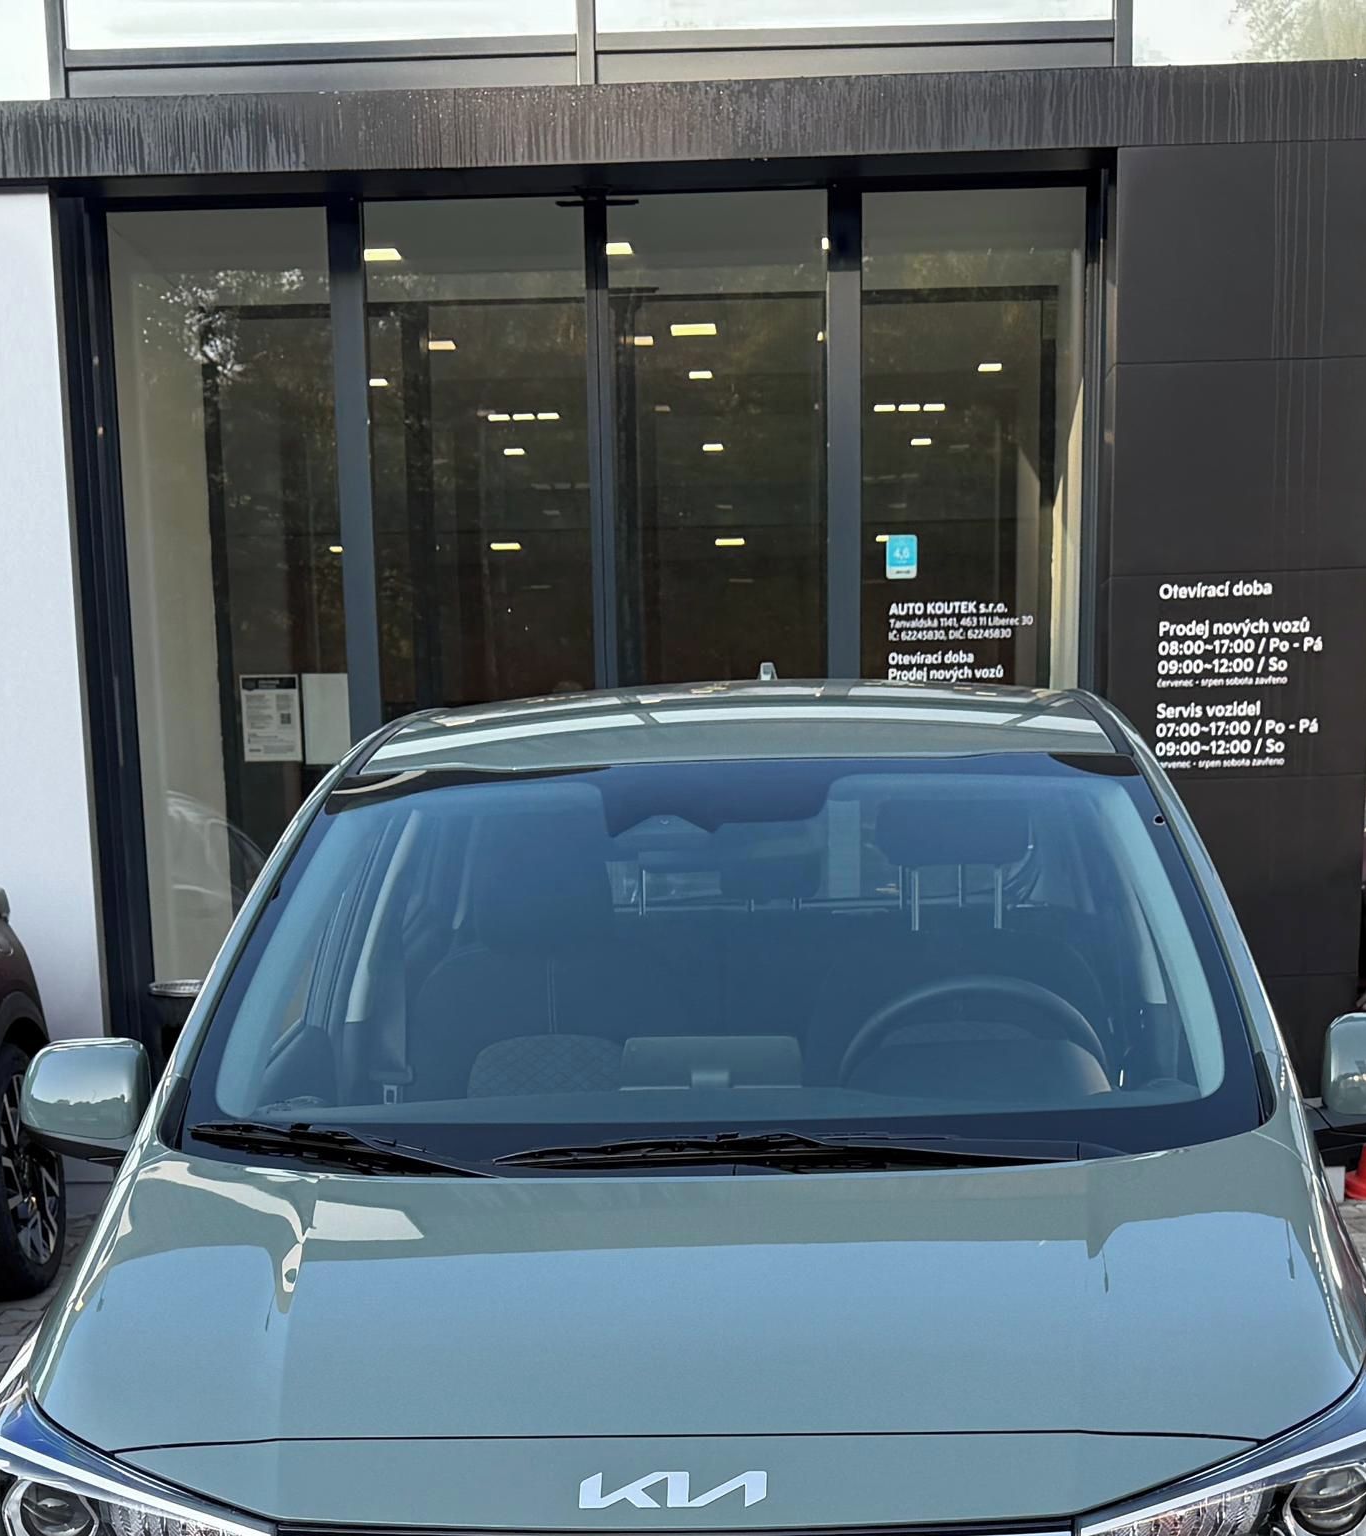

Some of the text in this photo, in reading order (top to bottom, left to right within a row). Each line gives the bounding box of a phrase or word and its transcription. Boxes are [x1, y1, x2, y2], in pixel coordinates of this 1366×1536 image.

[1158, 579, 1273, 600] Otevírací doba
[888, 600, 1008, 616] AUTO KOUTEK s.r.o.
[960, 615, 978, 627] 463
[978, 615, 987, 627] 11
[987, 615, 1020, 627] Liberec
[1021, 615, 1034, 626] 30
[1158, 616, 1311, 640] Prodej nových vozů
[888, 629, 900, 641] IČ:
[948, 628, 966, 640] DIČ:
[1157, 638, 1255, 656] 08:00~17:00
[1257, 637, 1267, 655] /
[1269, 637, 1290, 653] Po
[1302, 636, 1324, 652] Pá
[888, 649, 975, 665] Otevírací doba
[1157, 656, 1288, 675] 09:00~12:00 / So
[887, 664, 1004, 683] Prodej nových vozů
[1200, 677, 1225, 689] srpen
[1225, 675, 1254, 686] sobota
[1156, 700, 1262, 719] Servis vozidel
[1155, 720, 1252, 738] 07:00~17:00
[1253, 719, 1263, 737] /
[1265, 719, 1286, 735] Po
[1298, 718, 1319, 734] Pá
[1155, 738, 1285, 757] 09:00~12:00 / So
[1198, 759, 1222, 769] srpen
[1222, 758, 1251, 767] sobota
[578, 1470, 768, 1509] KIA
